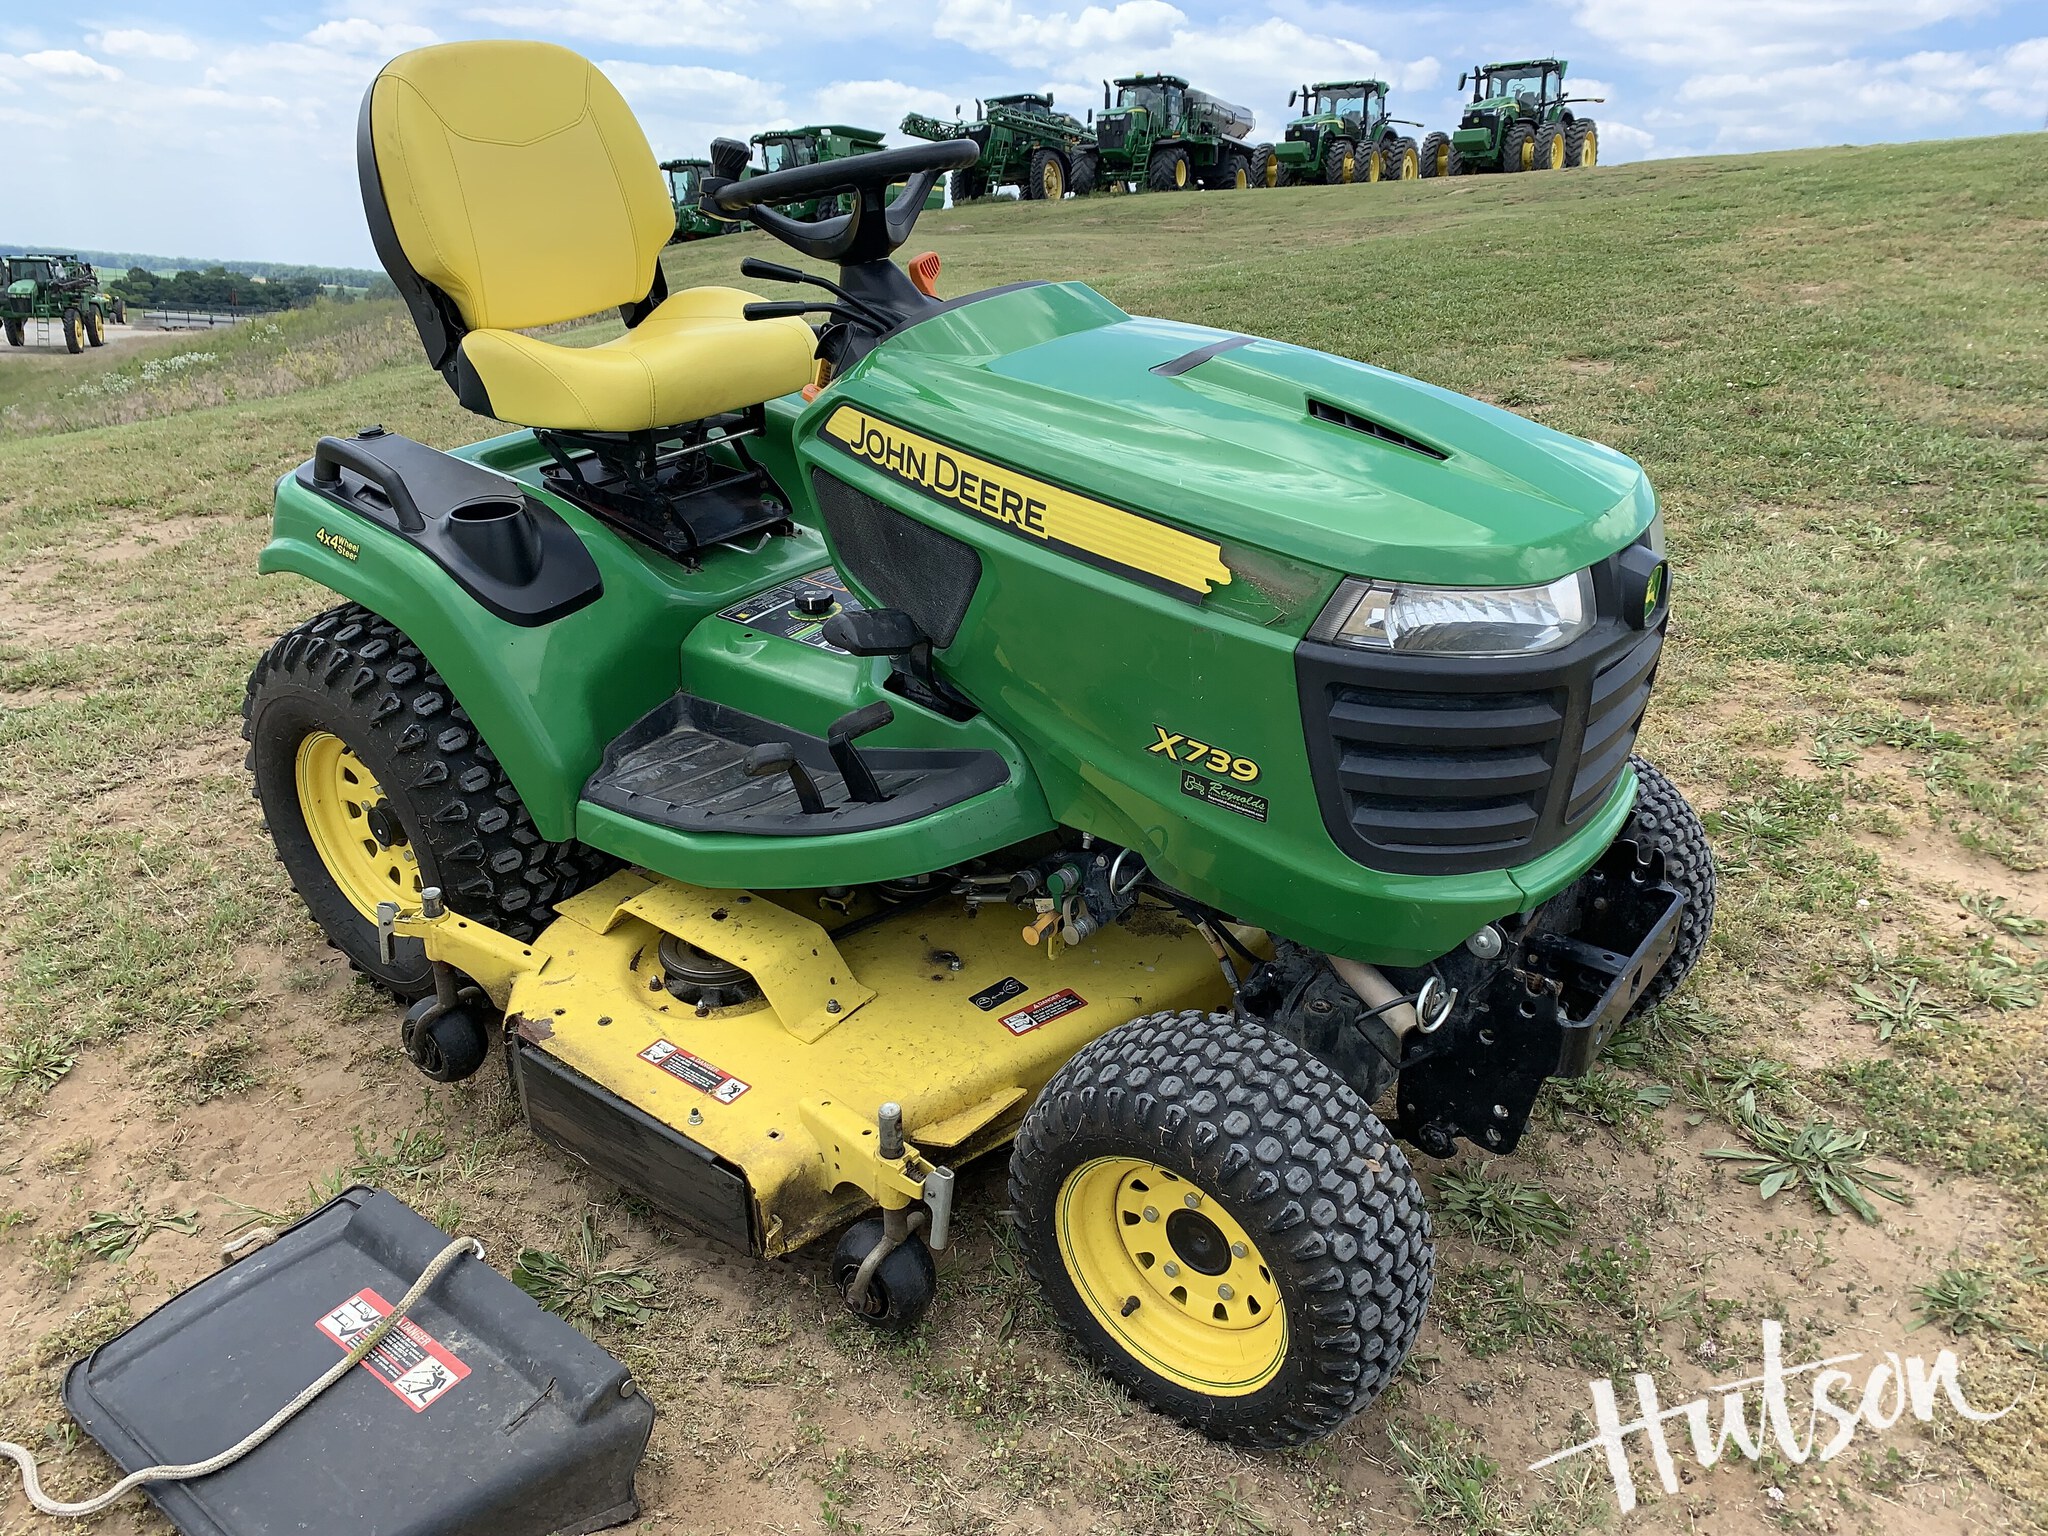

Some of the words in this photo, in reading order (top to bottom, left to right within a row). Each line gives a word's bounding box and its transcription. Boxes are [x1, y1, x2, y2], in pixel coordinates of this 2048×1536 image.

[851, 417, 927, 481] JOHN
[935, 452, 1048, 534] DEERE
[316, 527, 339, 550] 4x4
[338, 535, 360, 553] Wheel
[336, 545, 358, 561] Steer
[1149, 726, 1260, 782] X739
[1208, 781, 1266, 810] Reynolds
[695, 1057, 720, 1073] DANGER
[401, 1320, 432, 1347] DANGER
